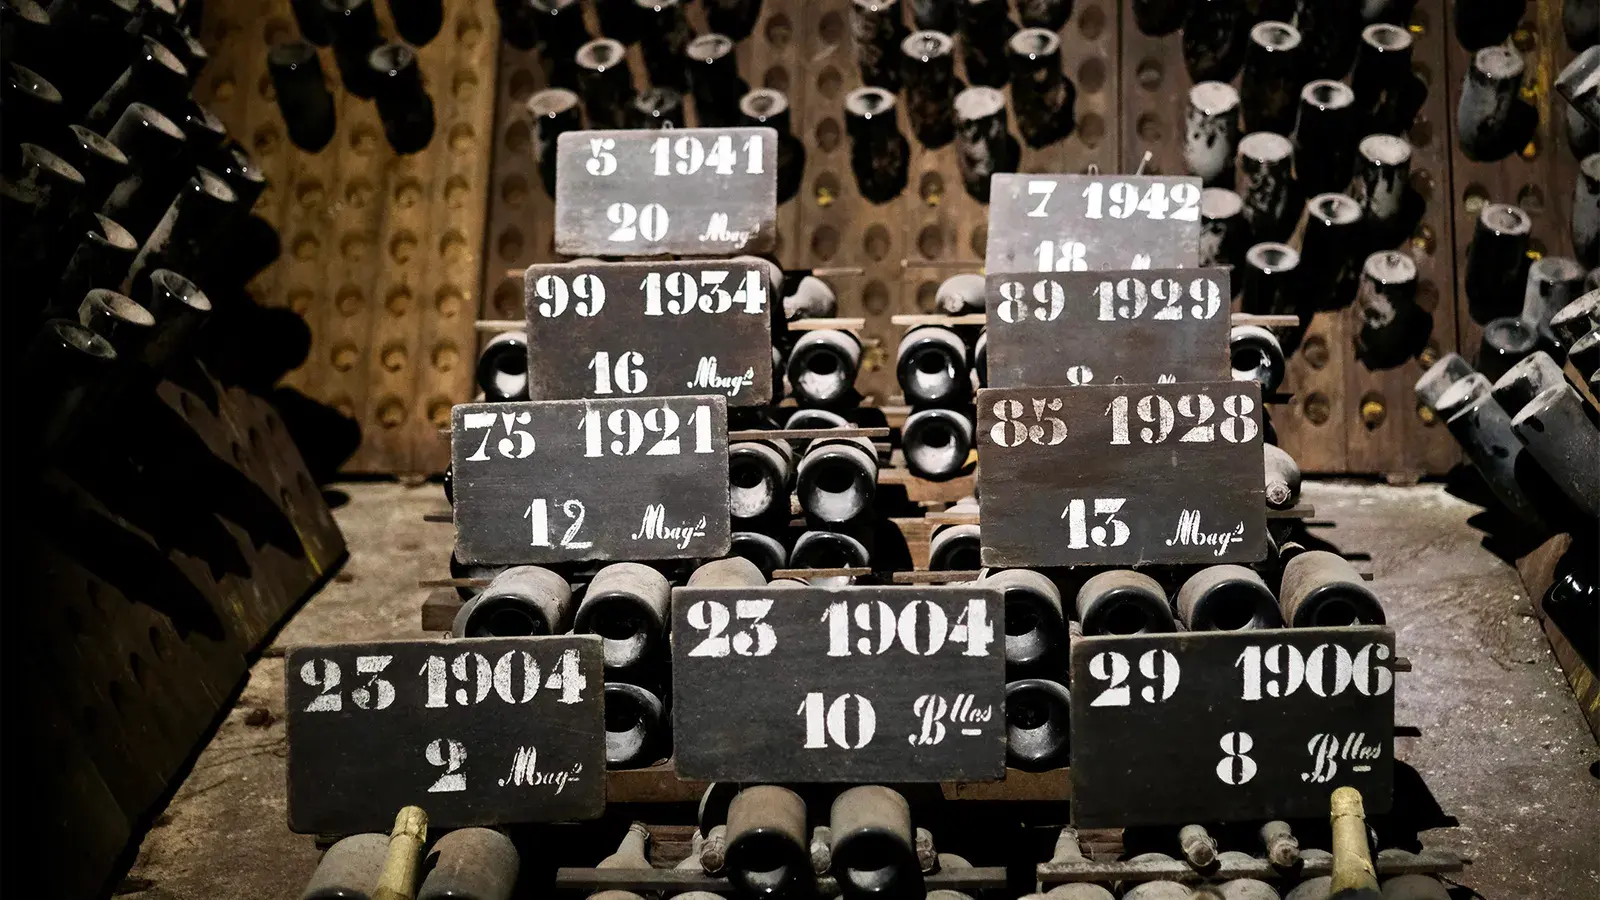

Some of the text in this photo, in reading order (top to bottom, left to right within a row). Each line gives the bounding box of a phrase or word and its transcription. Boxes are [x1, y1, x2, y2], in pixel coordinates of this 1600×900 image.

[585, 135, 764, 176] 5 1941
[606, 202, 669, 242] 20
[1027, 181, 1200, 221] 7 1942
[1034, 240, 1088, 271] 18
[534, 270, 767, 318] 99 1934
[997, 277, 1221, 323] 89 1929
[588, 351, 648, 395] 16
[463, 405, 715, 461] 75 1921
[989, 394, 1259, 448] 85 1928
[523, 498, 592, 550] 12
[1060, 498, 1131, 549] 13
[686, 598, 995, 657] 23 1904
[299, 648, 588, 712] 23 1904
[1088, 642, 1393, 707] 29 1906
[796, 692, 877, 750] 10
[425, 738, 468, 793] 2
[1215, 731, 1258, 785] 8
